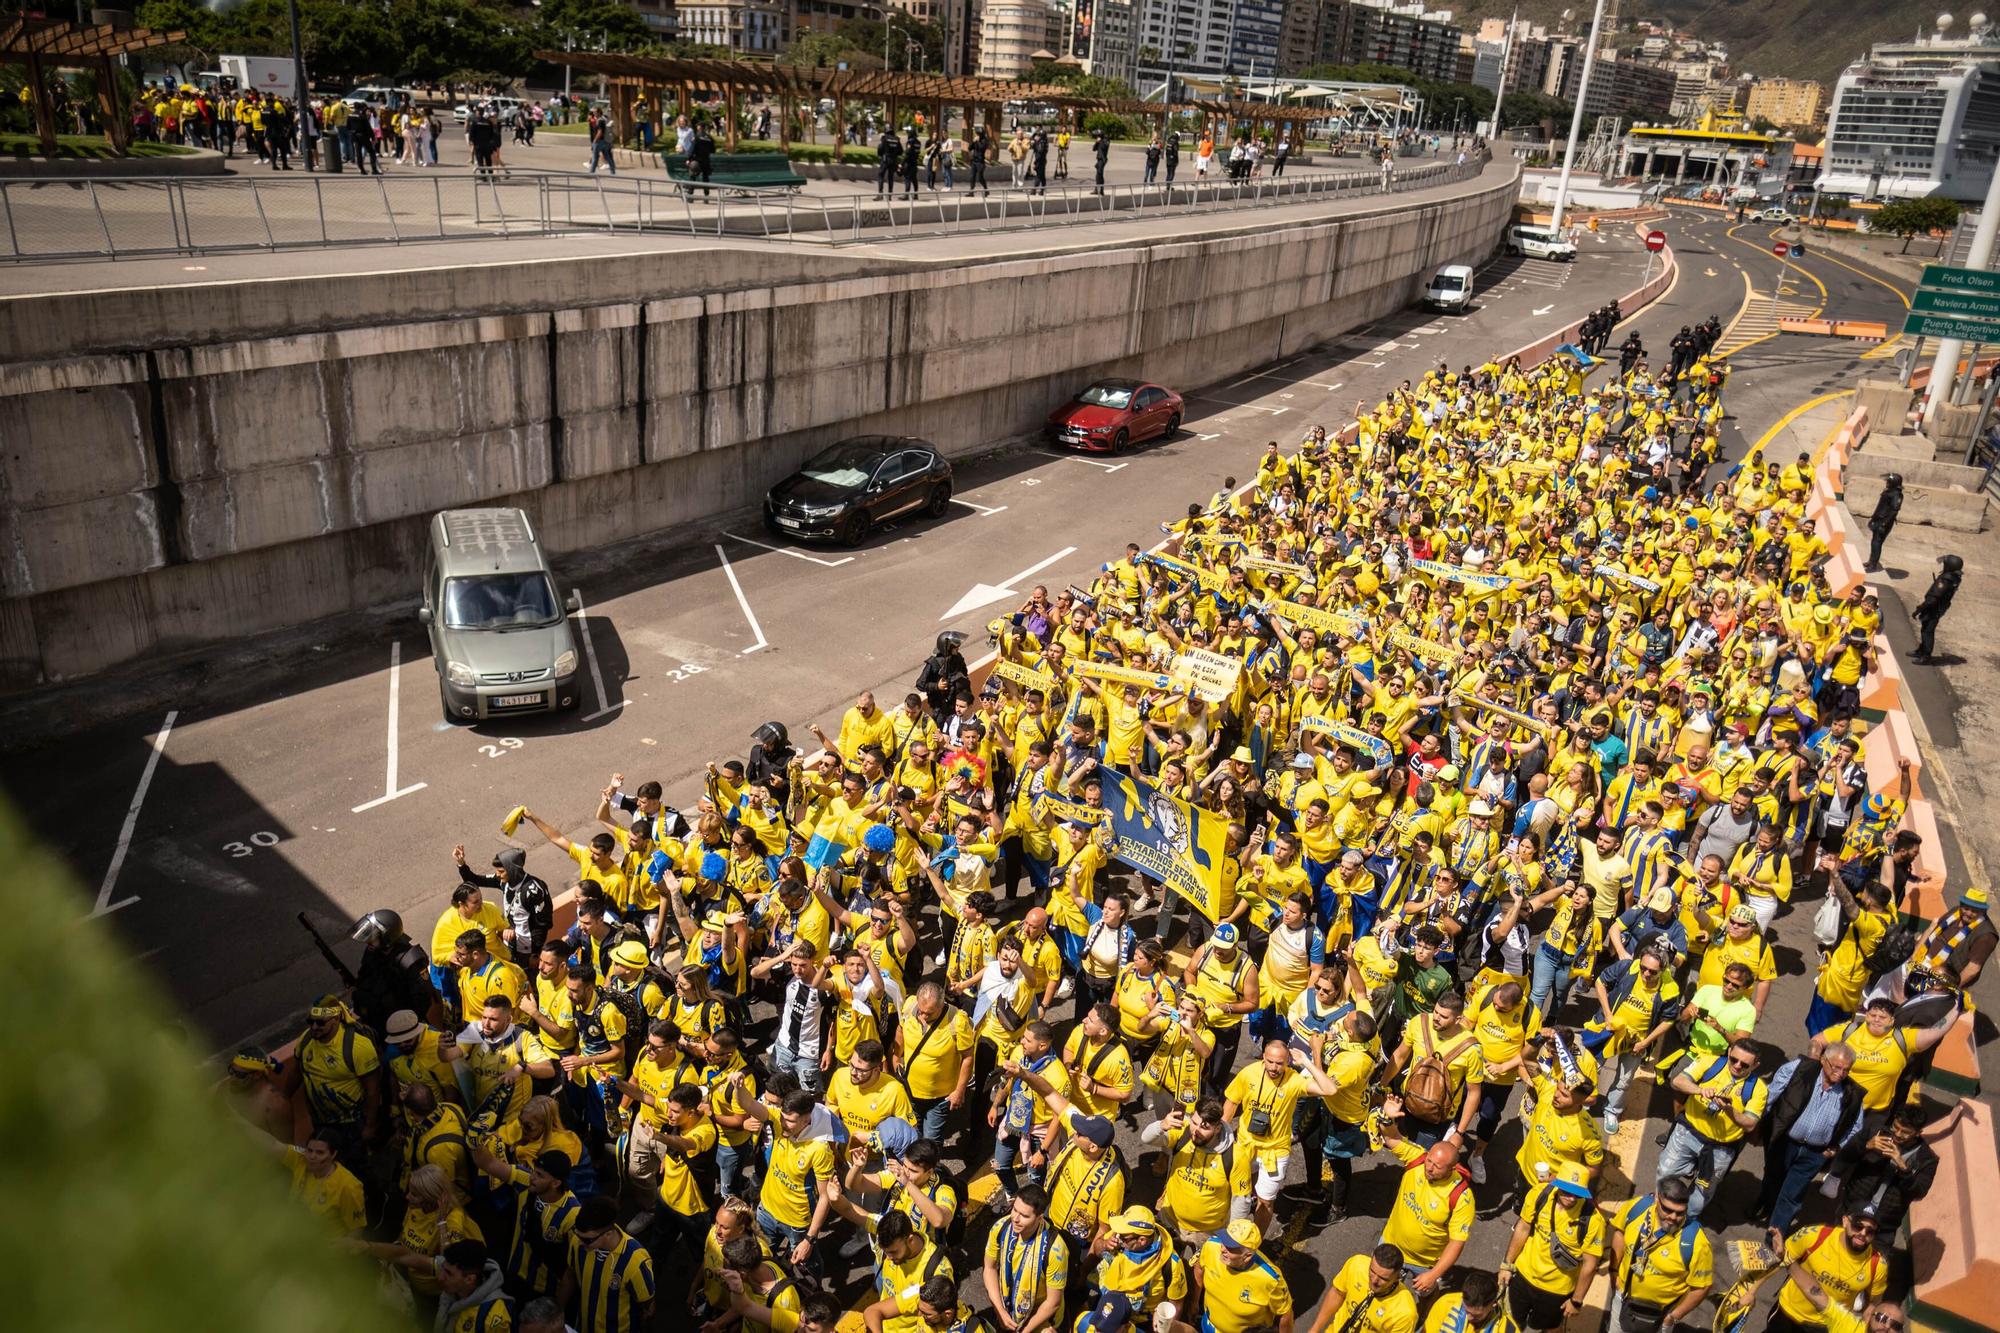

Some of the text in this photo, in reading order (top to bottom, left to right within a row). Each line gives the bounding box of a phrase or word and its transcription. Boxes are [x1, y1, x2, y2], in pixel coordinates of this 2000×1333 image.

[1941, 273, 1994, 287] Fred. Olsen
[1932, 298, 2000, 312] Naviera Armas
[1922, 318, 1953, 330] Puerto
[1920, 326, 1988, 341] Marina Santa Cruz
[1184, 648, 1196, 657] UN
[666, 663, 703, 680] 28
[478, 737, 524, 758] 29
[222, 831, 280, 858] 30
[1119, 835, 1133, 849] EL
[1134, 841, 1156, 858] MAR
[1156, 852, 1174, 869] NOS
[1120, 847, 1179, 883] ENTIMIENTO
[1179, 878, 1195, 895] NOS
[1194, 890, 1208, 909] UNE
[1487, 1021, 1506, 1033] Gran
[641, 1080, 659, 1096] Gran
[847, 1111, 870, 1125] Gran
[1186, 1166, 1209, 1184] Gran
[407, 1228, 426, 1245] Gran
